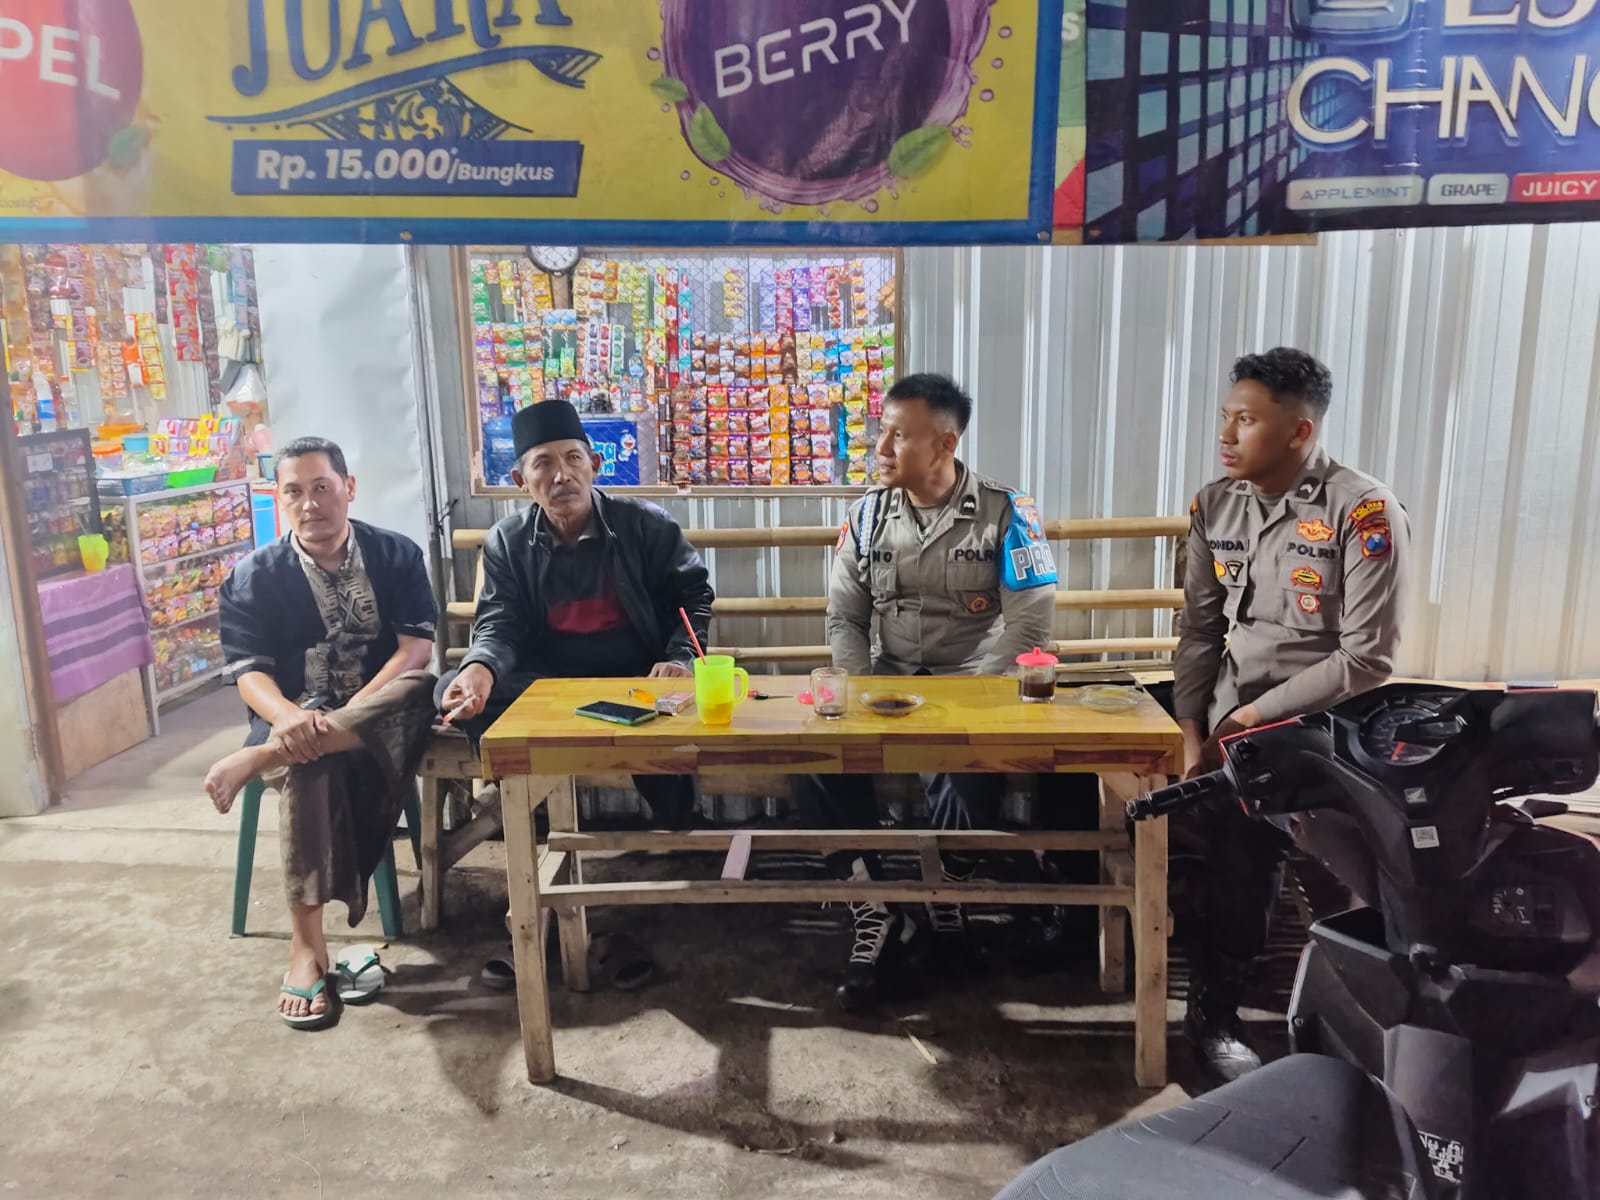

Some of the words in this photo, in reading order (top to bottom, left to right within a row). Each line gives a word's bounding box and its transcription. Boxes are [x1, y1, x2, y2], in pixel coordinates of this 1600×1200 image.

[714, 0, 918, 98] BERRY
[1287, 54, 1600, 144] CHAN
[256, 150, 317, 189] Rp.
[1300, 185, 1413, 200] APPLEMINT
[1440, 183, 1498, 197] GRAPE
[1521, 179, 1598, 197] JUICY
[1286, 542, 1337, 559] POLRI
